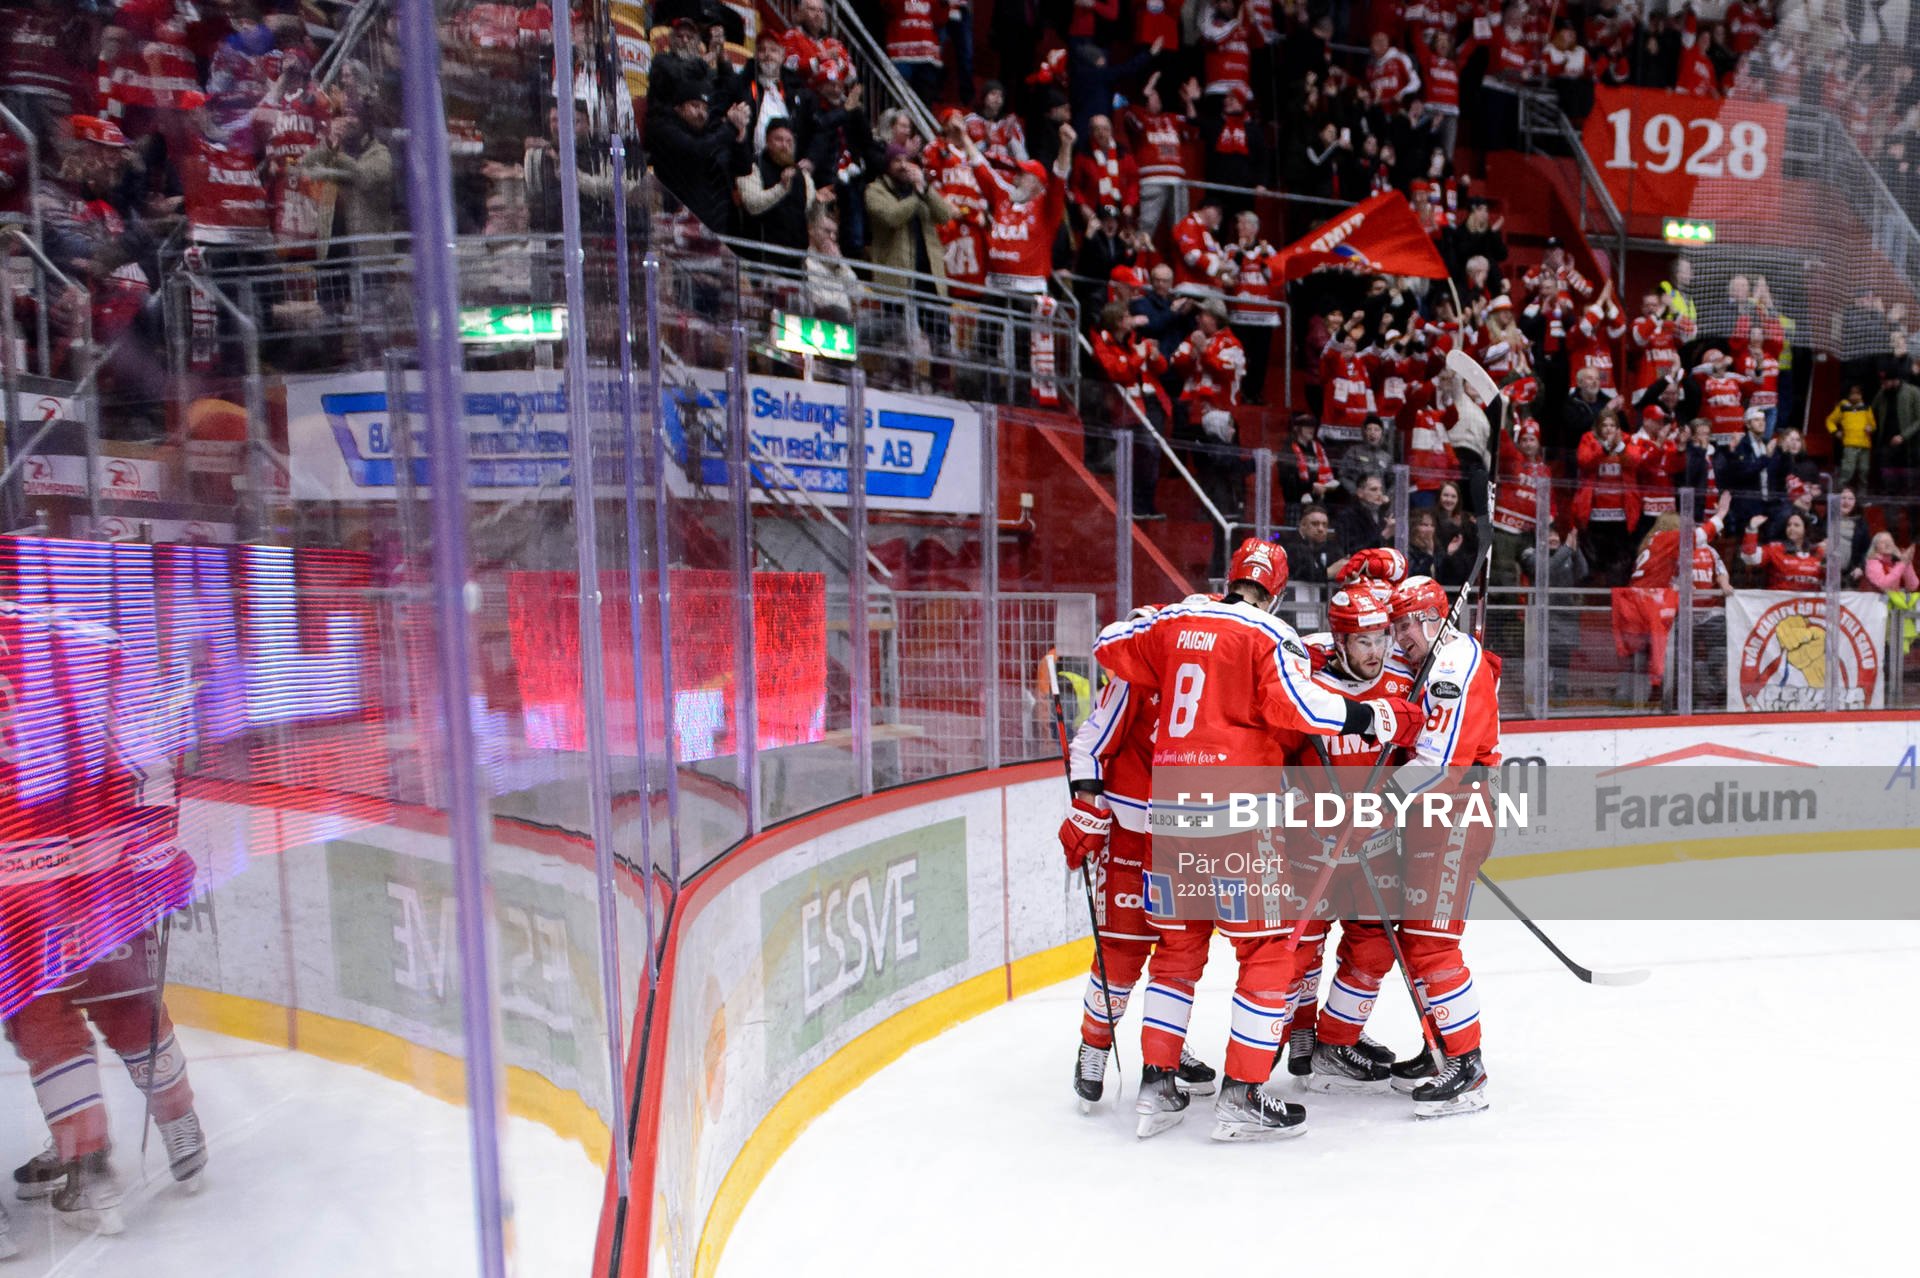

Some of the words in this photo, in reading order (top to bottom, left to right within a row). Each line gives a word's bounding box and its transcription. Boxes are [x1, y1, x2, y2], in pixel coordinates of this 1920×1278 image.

[1604, 108, 1768, 180] 1928
[881, 438, 913, 468] AB
[1251, 567, 1261, 579] 8
[1176, 630, 1217, 651] PAIGIN
[1170, 662, 1206, 738] 8
[1425, 704, 1453, 734] 81
[1177, 750, 1197, 764] with
[1198, 750, 1216, 765] love
[1595, 780, 1818, 832] Faradium
[1435, 820, 1469, 920] PEAB
[802, 858, 918, 1016] ESSVE
